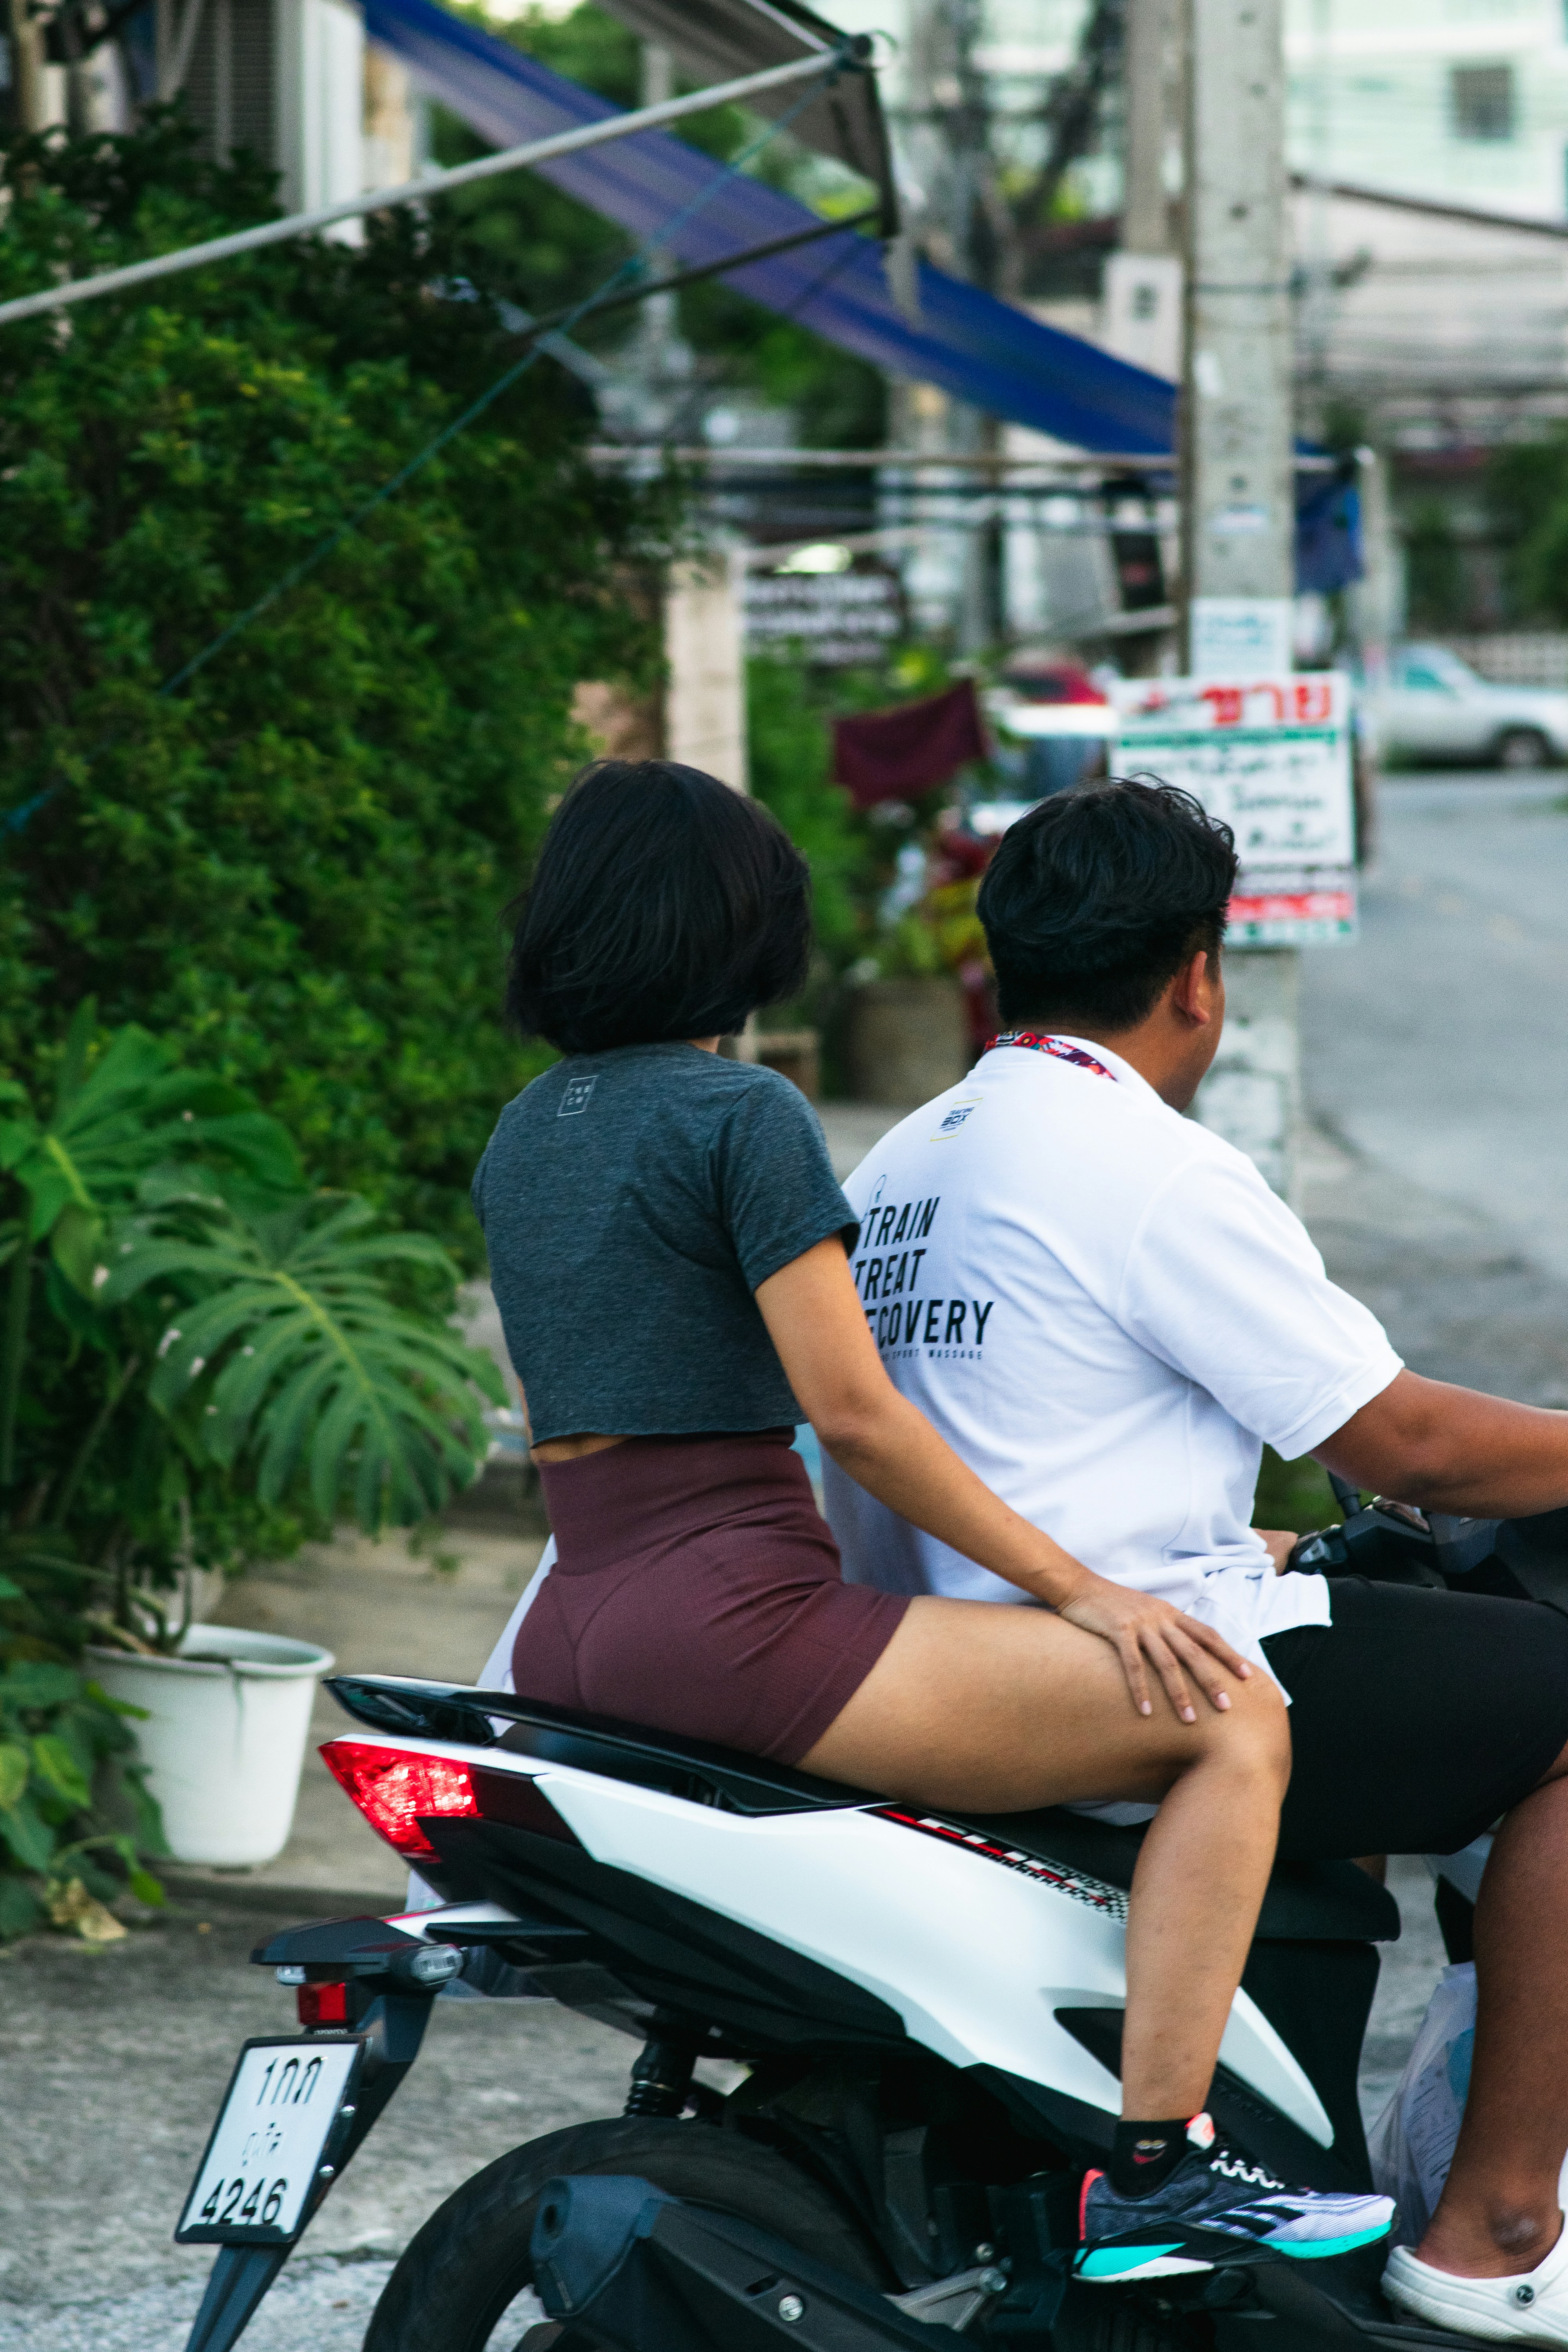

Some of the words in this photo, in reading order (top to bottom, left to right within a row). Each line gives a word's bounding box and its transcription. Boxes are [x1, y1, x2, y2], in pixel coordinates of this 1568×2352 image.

[862, 1196, 940, 1248] TRAIN
[855, 1249, 927, 1300] TREAT
[864, 1299, 995, 1349] COVERY
[200, 2177, 287, 2224] 4246
